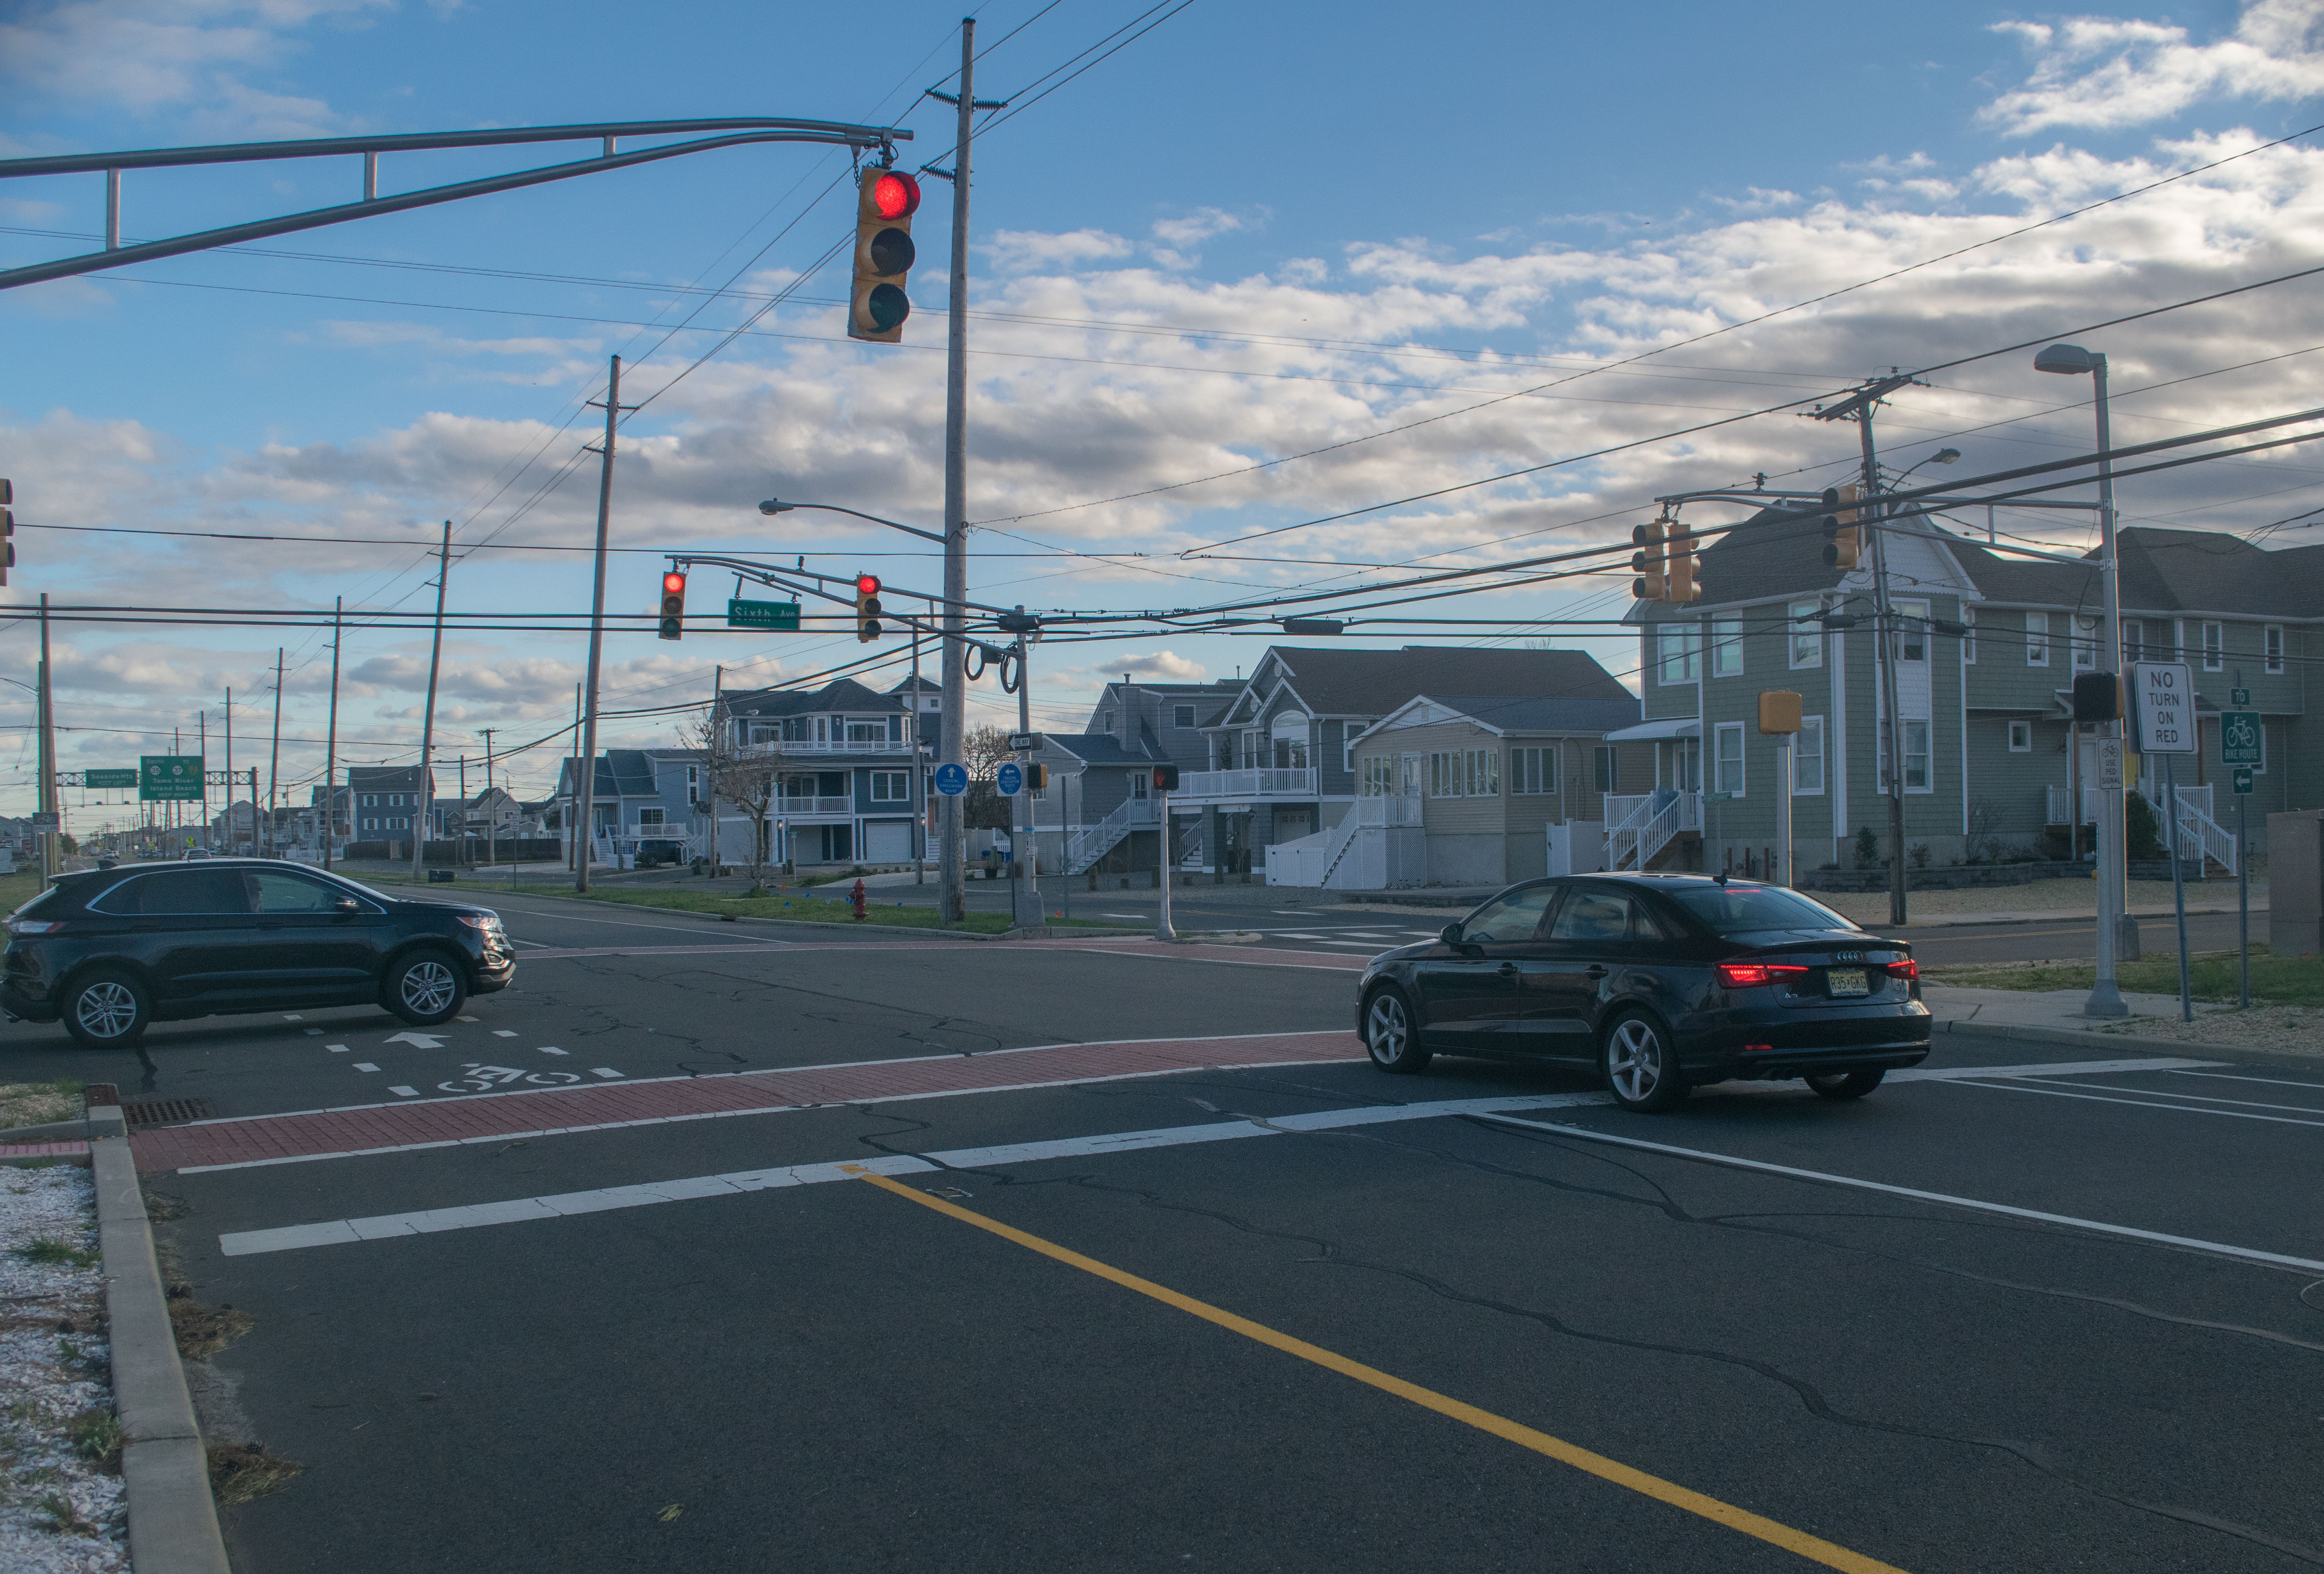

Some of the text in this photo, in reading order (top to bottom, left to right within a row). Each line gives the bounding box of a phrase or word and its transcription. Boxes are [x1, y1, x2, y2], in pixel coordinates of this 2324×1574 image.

[735, 607, 771, 622] Sixth
[2150, 672, 2173, 688] NO
[2149, 693, 2179, 706] TURN
[2236, 692, 2245, 702] TO
[2158, 711, 2173, 725] ON
[2156, 730, 2178, 743] RED
[2225, 749, 2258, 759] BIKE ROUTE
